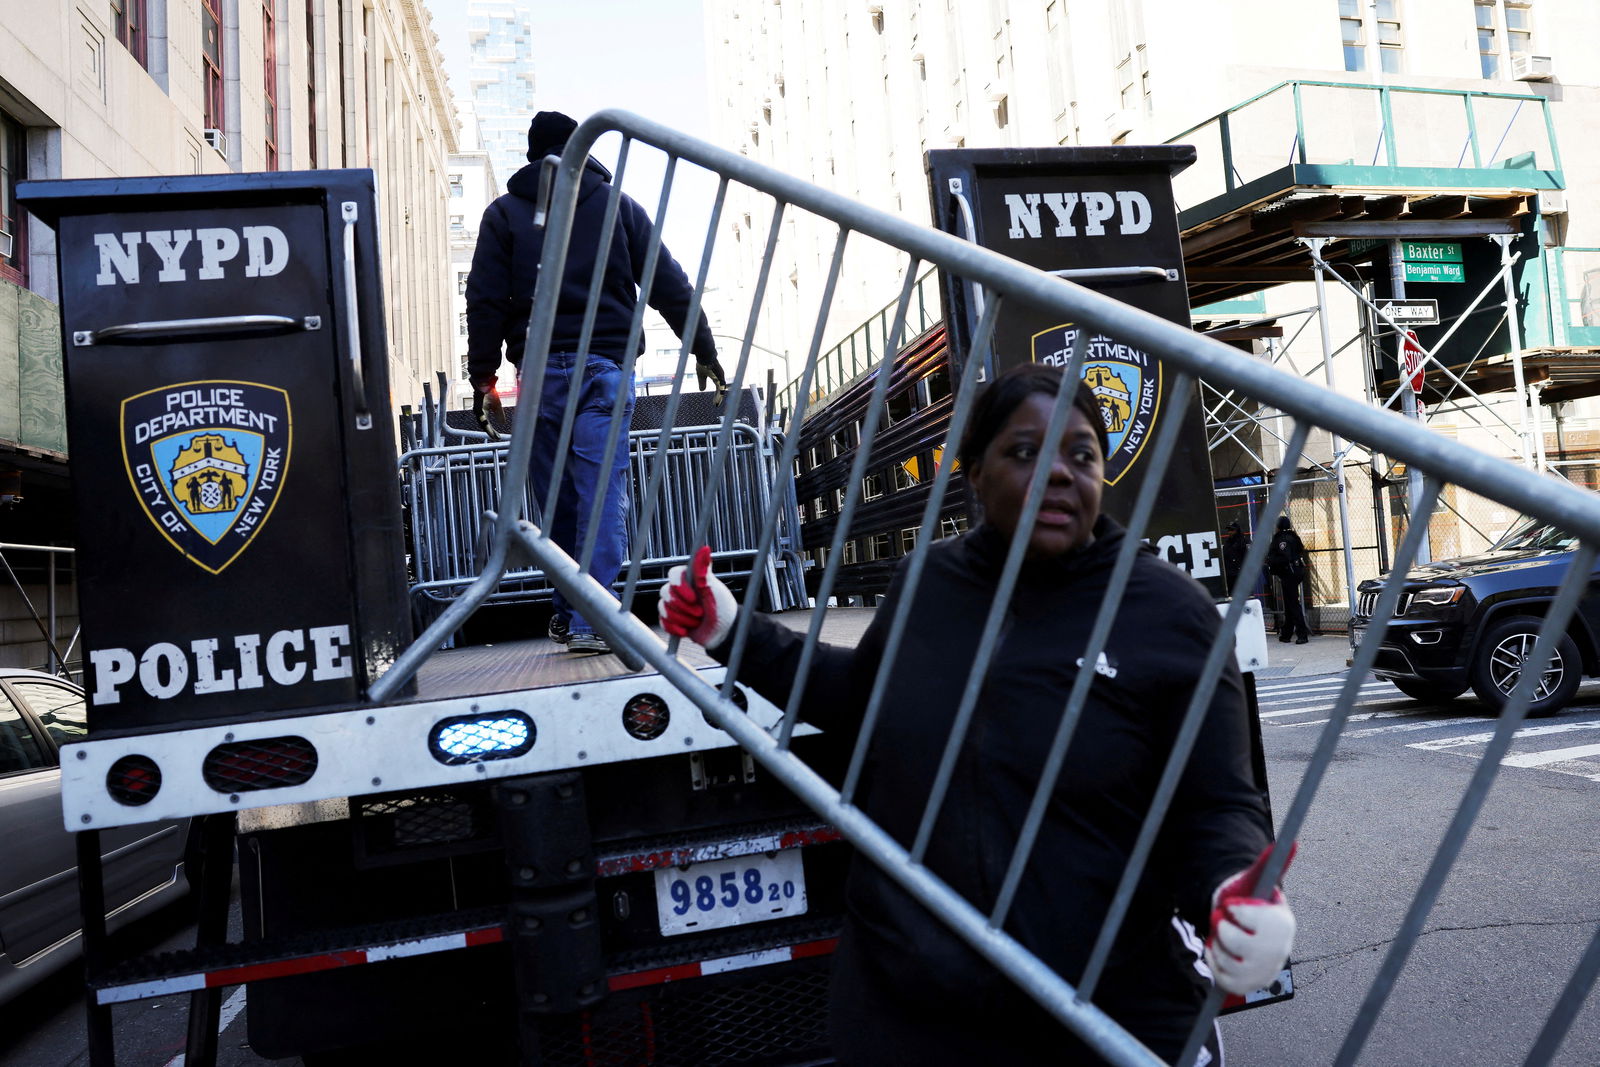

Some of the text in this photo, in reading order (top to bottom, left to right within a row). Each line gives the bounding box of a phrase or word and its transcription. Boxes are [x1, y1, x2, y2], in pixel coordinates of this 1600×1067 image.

[1004, 190, 1152, 239] NYPD
[93, 225, 290, 286] NYPD
[1406, 264, 1461, 277] Benjamin Ward
[1408, 244, 1455, 260] Baxter St
[1385, 307, 1430, 317] ONE WAY
[1042, 342, 1149, 369] DEPRTMENT
[166, 388, 245, 412] POLICE
[1123, 378, 1155, 455] NEW YORK
[135, 406, 278, 445] DEPARTMENT
[136, 463, 188, 534] CITY OF
[234, 447, 282, 538] NEW YORK
[89, 624, 353, 706] POLICE
[670, 868, 796, 916] 9858 20
